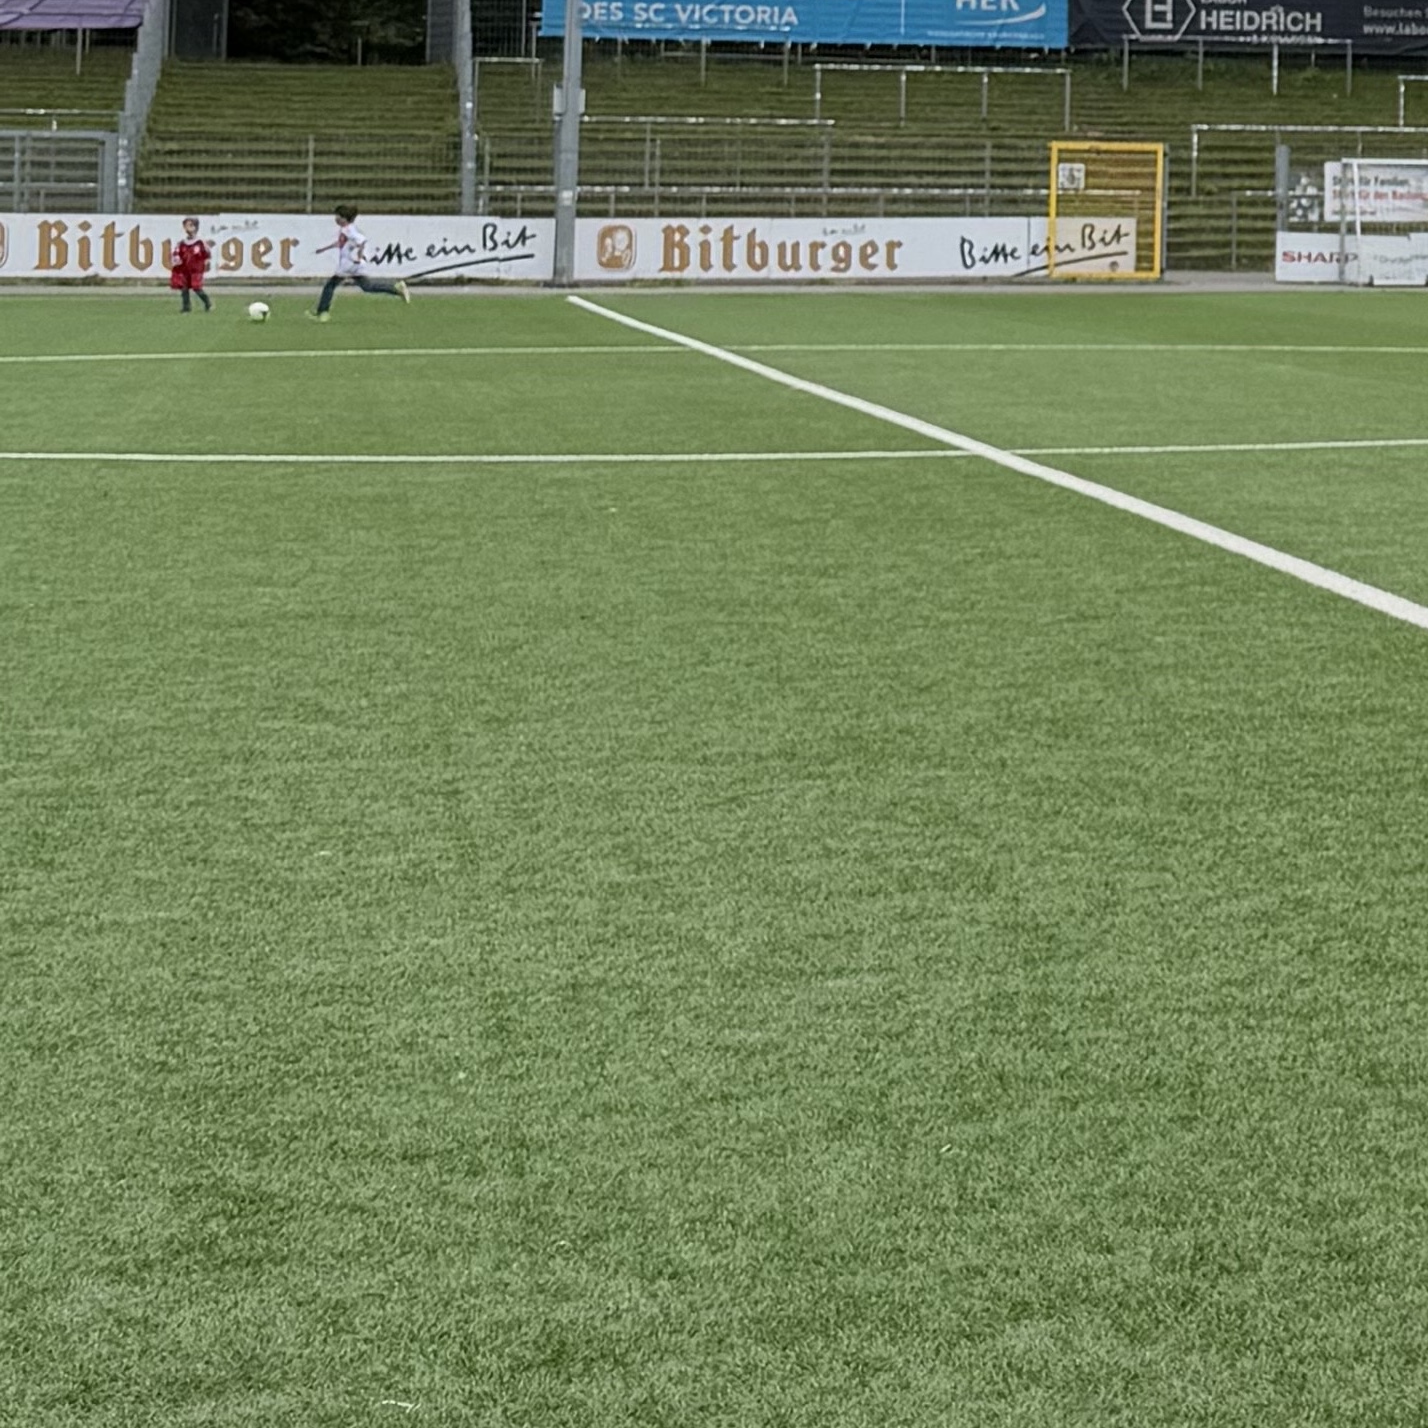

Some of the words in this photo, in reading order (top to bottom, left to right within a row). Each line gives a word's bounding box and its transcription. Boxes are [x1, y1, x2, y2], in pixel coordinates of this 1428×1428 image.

[633, 2, 665, 22] SC
[675, 3, 799, 26] VICTORIA
[1200, 10, 1322, 32] HEIDRICH
[33, 220, 300, 271] Bitbger
[363, 245, 418, 266] itte
[425, 237, 476, 257] ein
[481, 222, 537, 252] Bit
[659, 223, 903, 273] Bitburger
[959, 235, 1021, 270] Bitte
[1081, 223, 1130, 250] Bit
[1282, 250, 1359, 264] SHARP
